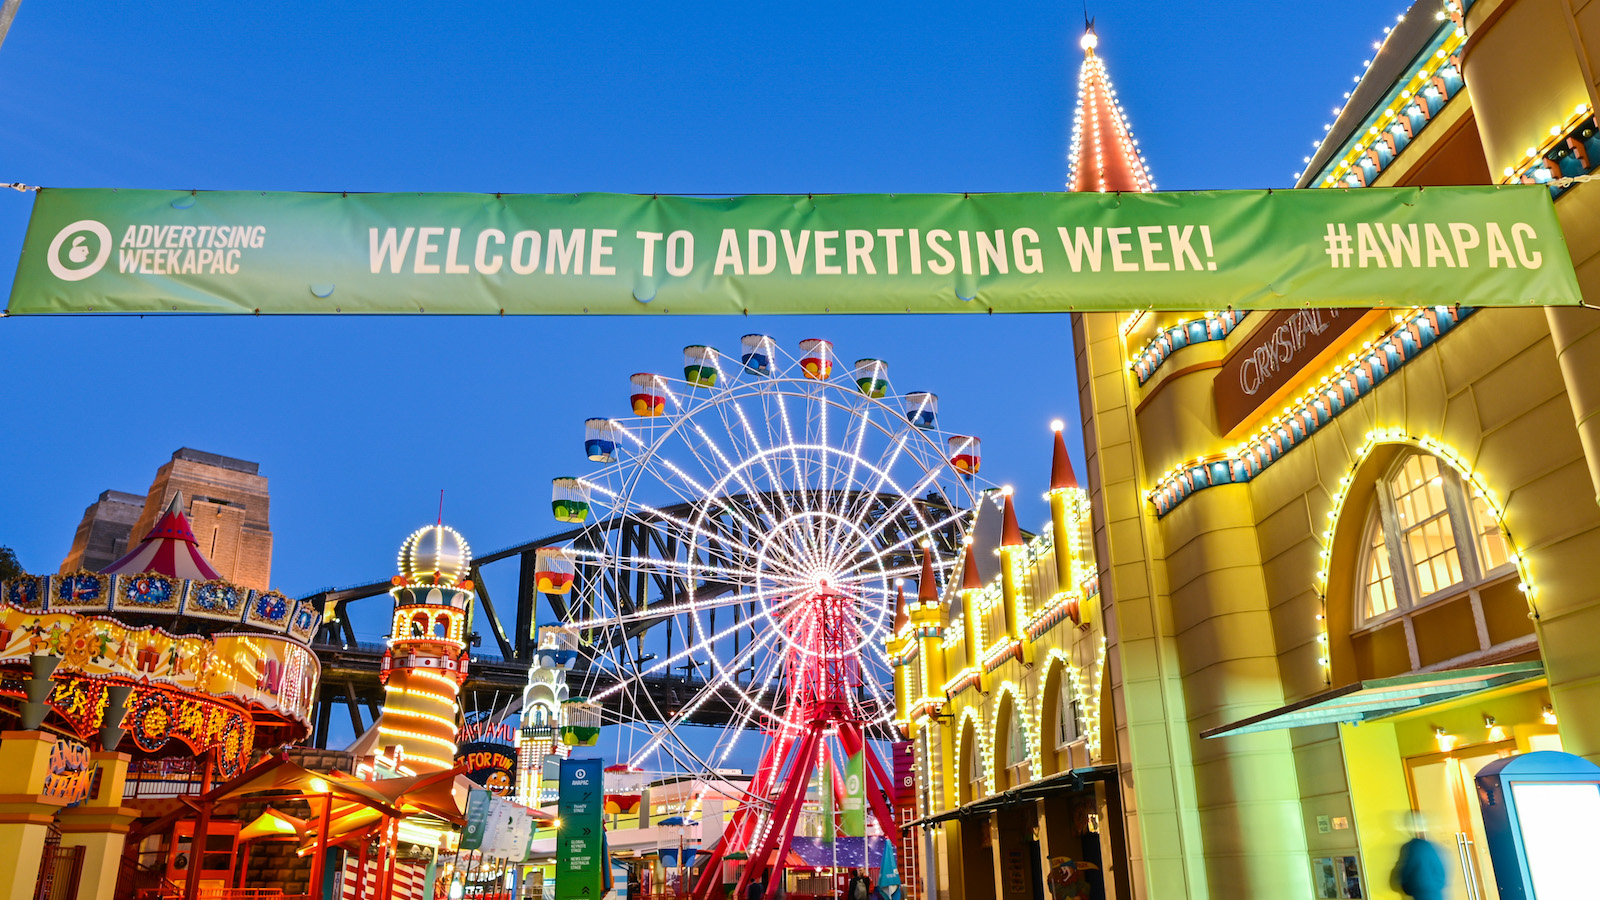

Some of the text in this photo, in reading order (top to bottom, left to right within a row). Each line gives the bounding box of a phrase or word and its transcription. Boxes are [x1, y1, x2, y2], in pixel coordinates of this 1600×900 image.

[120, 225, 266, 248] ADVERTISING
[369, 225, 1217, 277] WELCOME TO ADVERTISING WEEK!
[1324, 222, 1543, 270] #AWAPAC
[119, 249, 241, 274] WEEKAPAC
[1239, 308, 1330, 396] CRYSTAL
[467, 752, 492, 773] FOR
[492, 753, 513, 770] FUN
